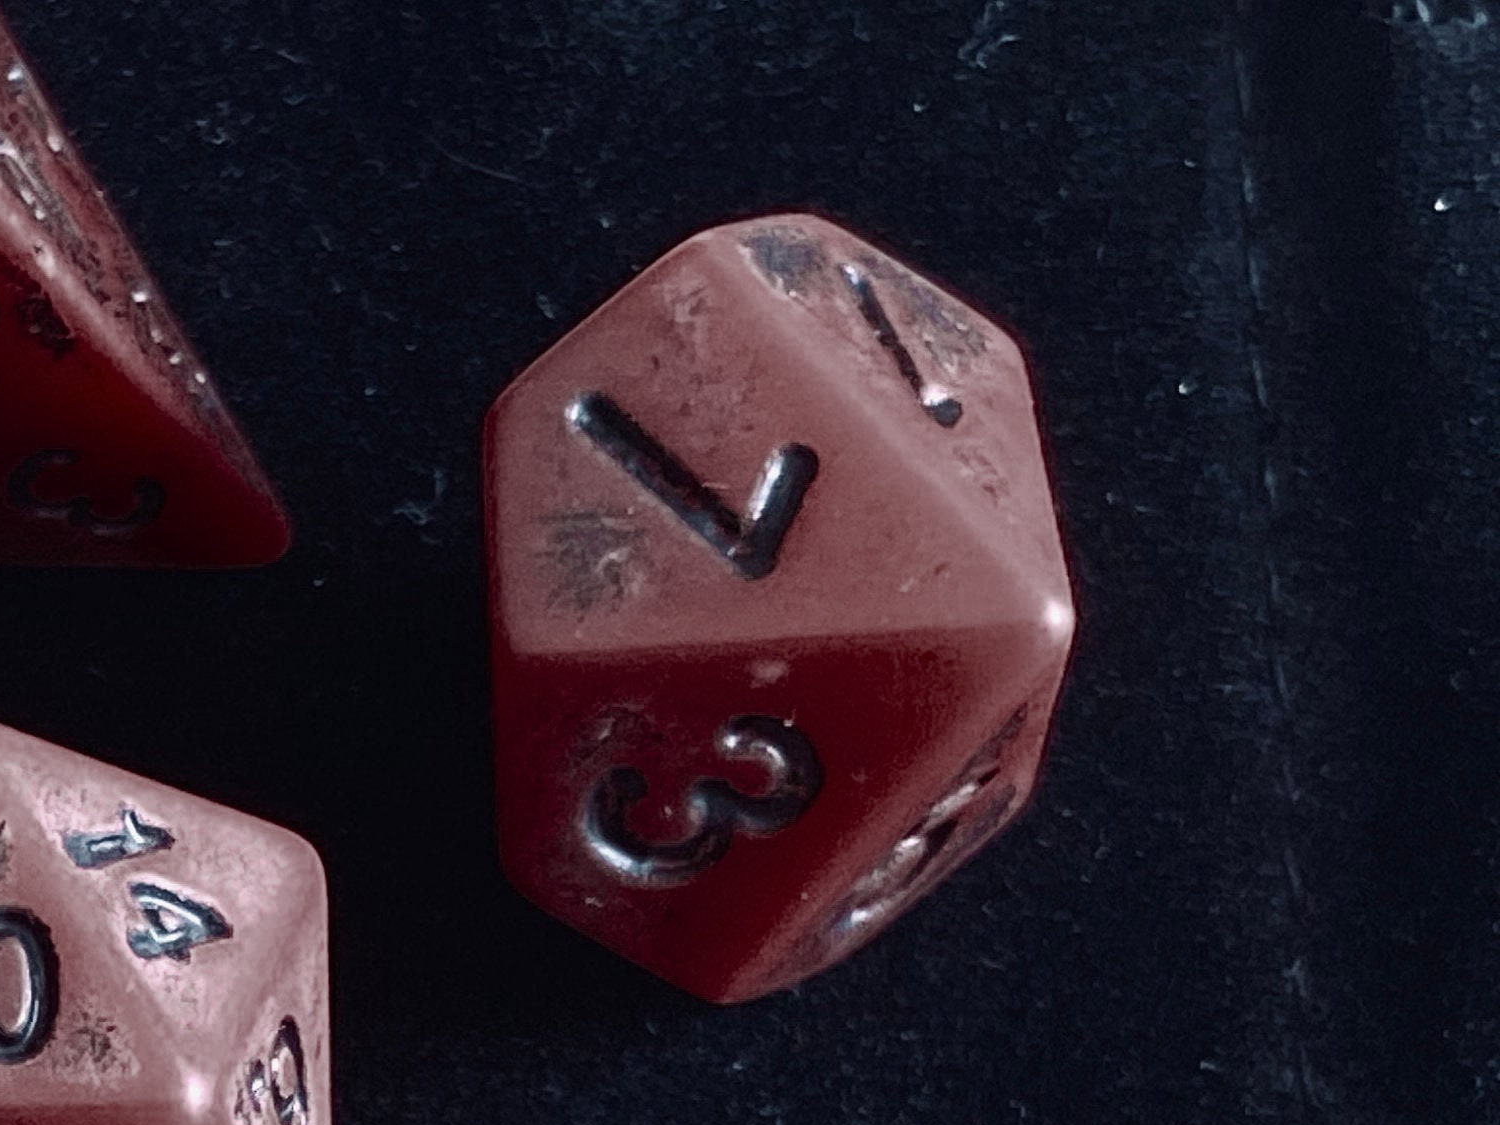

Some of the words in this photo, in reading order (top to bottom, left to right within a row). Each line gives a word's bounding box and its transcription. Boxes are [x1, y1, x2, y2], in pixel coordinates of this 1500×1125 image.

[5, 447, 166, 537] 3
[564, 390, 819, 581] 7
[578, 713, 825, 890] 3
